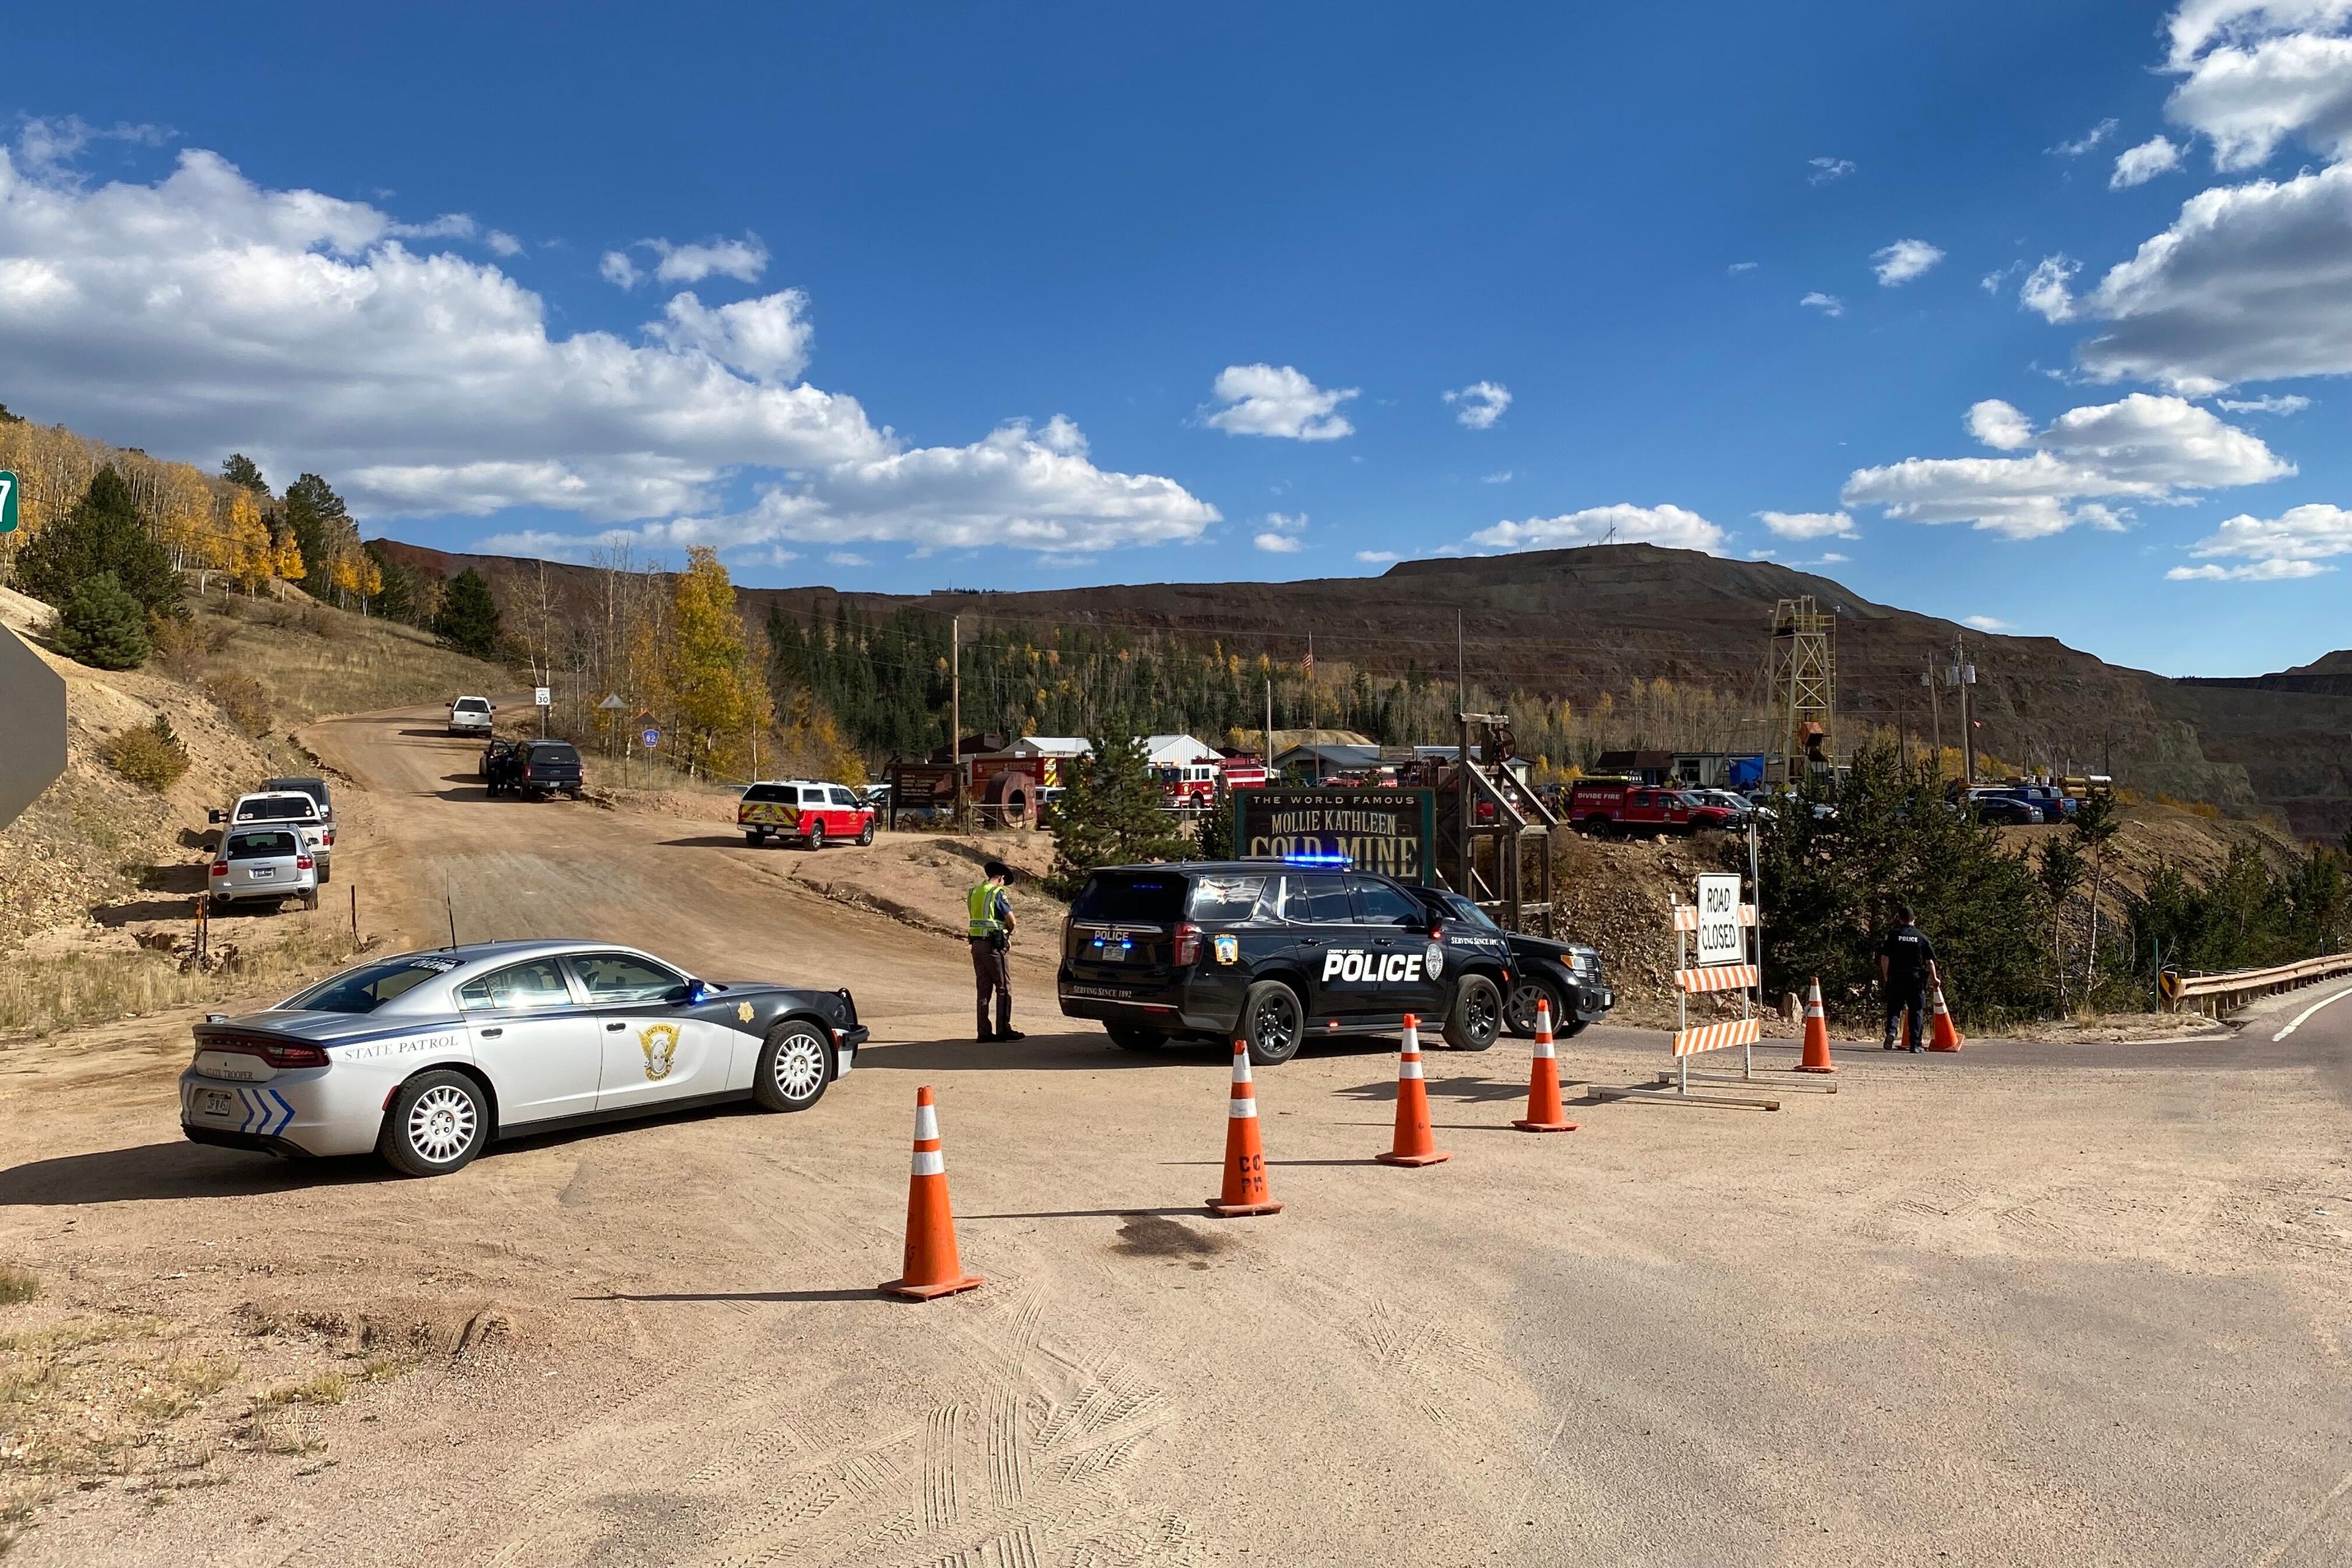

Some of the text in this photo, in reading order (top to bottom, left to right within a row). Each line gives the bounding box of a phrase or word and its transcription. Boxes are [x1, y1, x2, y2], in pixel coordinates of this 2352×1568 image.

[0, 480, 11, 522] 7
[1272, 810, 1396, 835] MOLLIE KATHLEEN
[1335, 837, 1417, 877] MINE
[1707, 888, 1730, 913] ROAD
[1095, 930, 1129, 941] POLICE
[1702, 924, 1736, 951] CLOSED
[1322, 954, 1423, 982] POLICE
[1073, 985, 1097, 995] SERVING
[1097, 987, 1117, 997] SINCE
[345, 1036, 459, 1060] STATE PATROL
[206, 1068, 254, 1080] STATE TROOPER
[1239, 1154, 1260, 1172] CC
